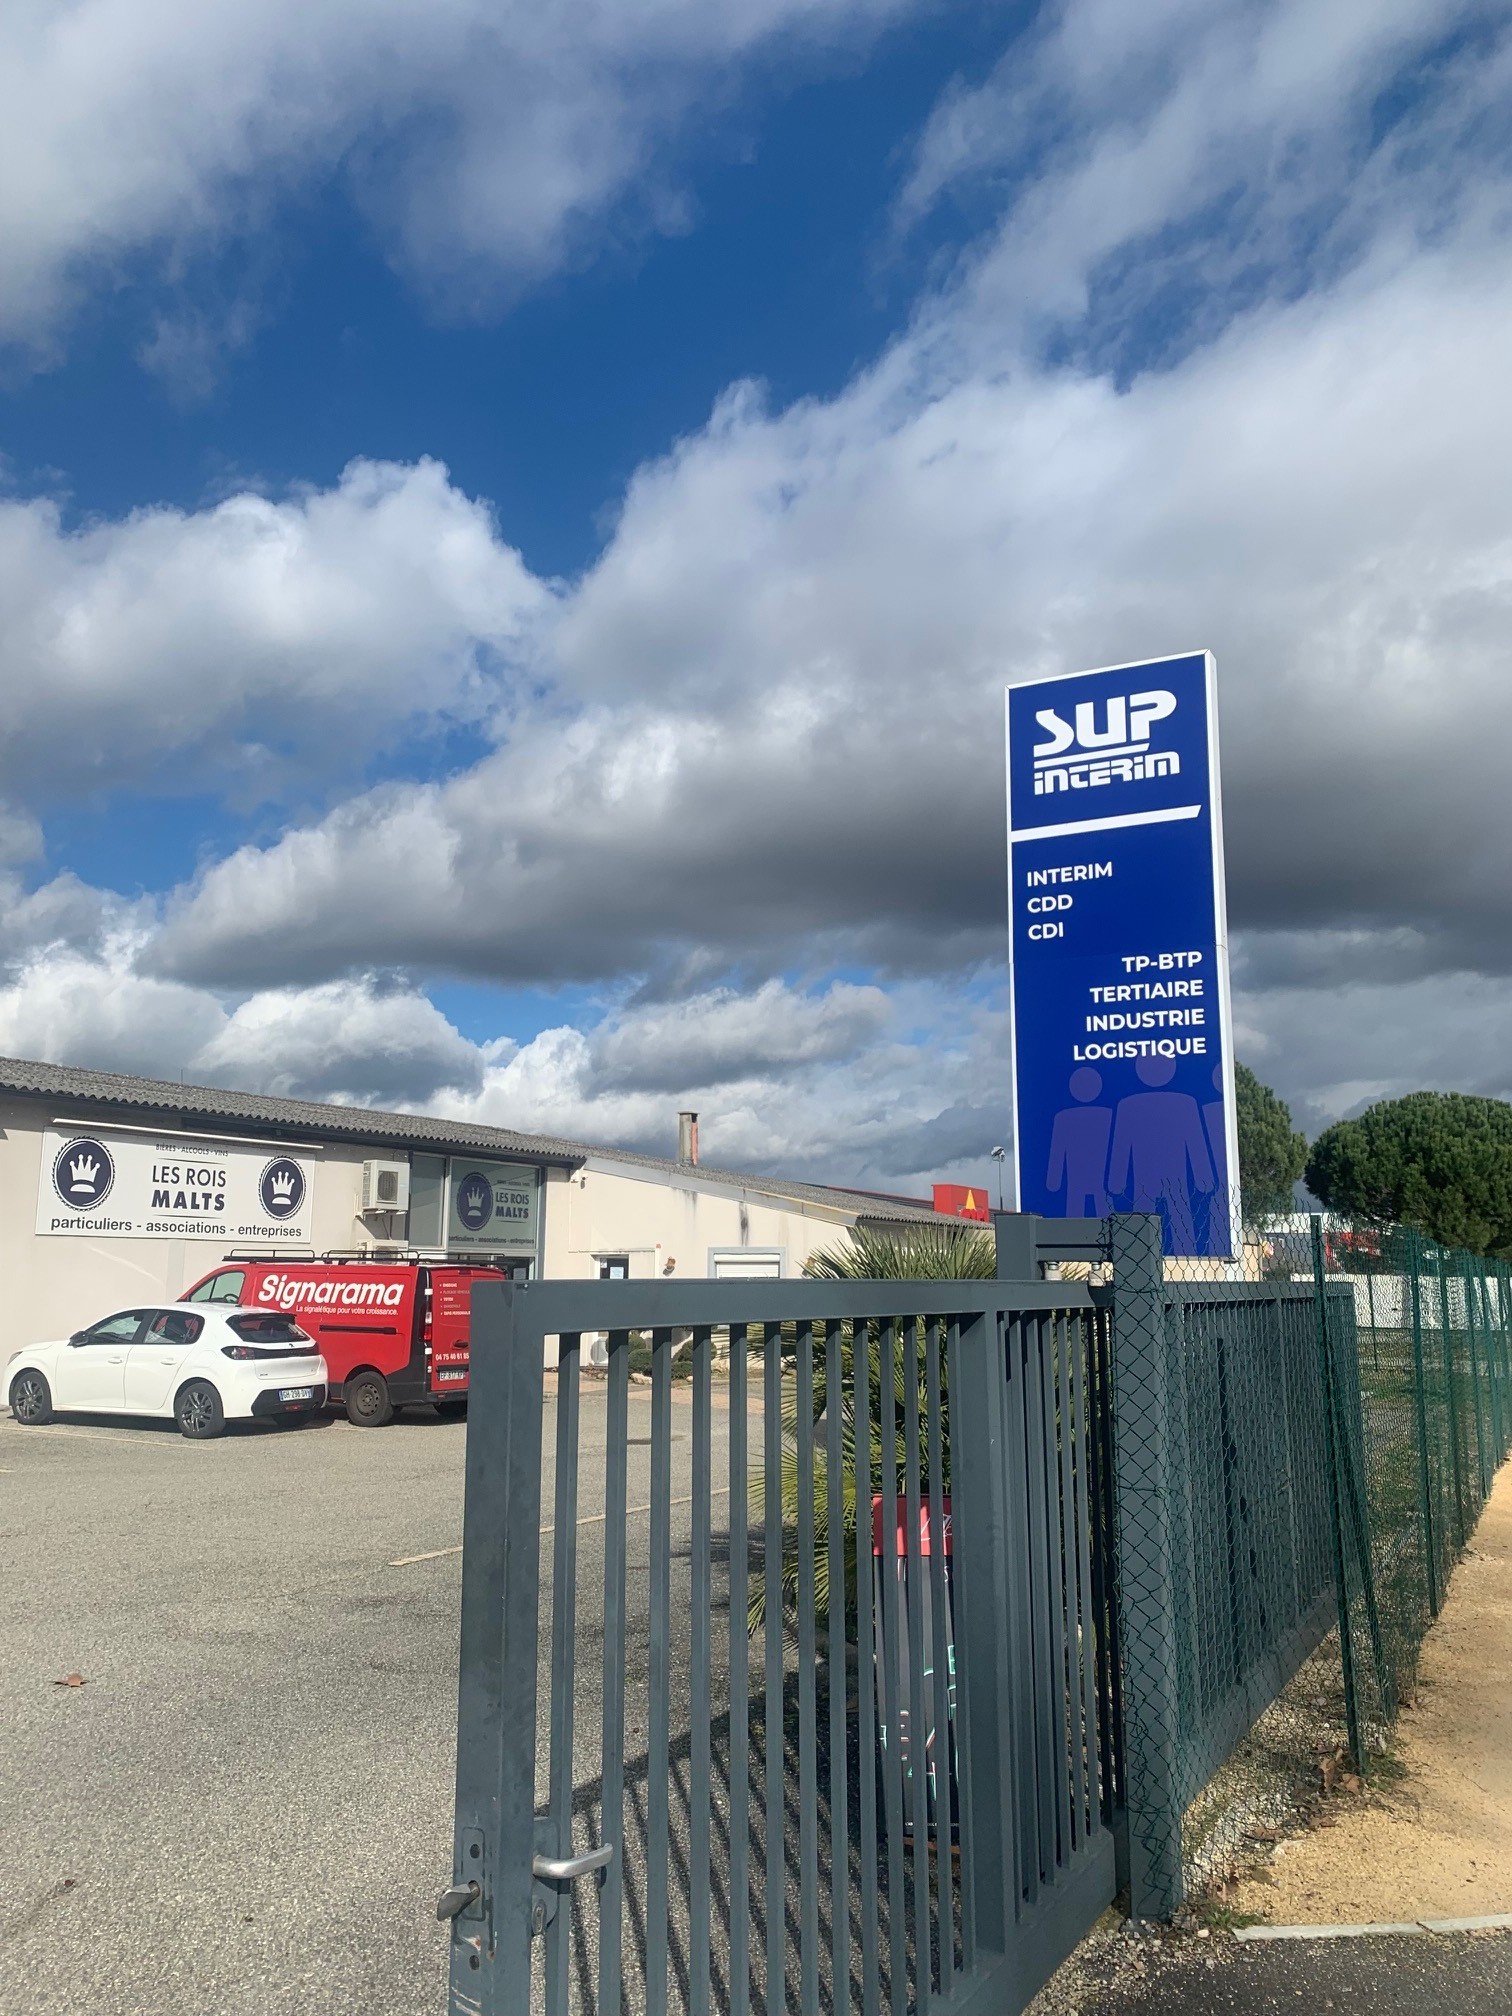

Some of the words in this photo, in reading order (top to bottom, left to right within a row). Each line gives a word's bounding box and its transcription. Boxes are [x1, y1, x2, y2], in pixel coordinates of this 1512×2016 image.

[1034, 690, 1177, 757] SUP
[1027, 861, 1113, 887] INTERIM
[1027, 894, 1073, 913] CDD
[1028, 922, 1064, 940] CDI
[1122, 951, 1202, 973] TP-BTP
[1090, 979, 1203, 1003] TERTIAIRE
[1086, 1008, 1205, 1032] INDUSTRIE
[1073, 1037, 1206, 1061] LOGISTIQUE
[181, 1146, 209, 1155] ALCOOLS
[214, 1149, 229, 1157] VINS
[152, 1165, 180, 1184] LES
[186, 1168, 226, 1187] ROIS
[151, 1189, 225, 1211] MALTS
[495, 1192, 509, 1203] LES
[510, 1193, 530, 1205] ROIS
[495, 1206, 529, 1219] MALTS
[50, 1217, 132, 1231] particuliers
[146, 1220, 226, 1234] associations
[238, 1225, 302, 1239] entreprises
[258, 1274, 404, 1309] Signarama
[337, 1307, 351, 1315] pour
[351, 1306, 365, 1314] votre
